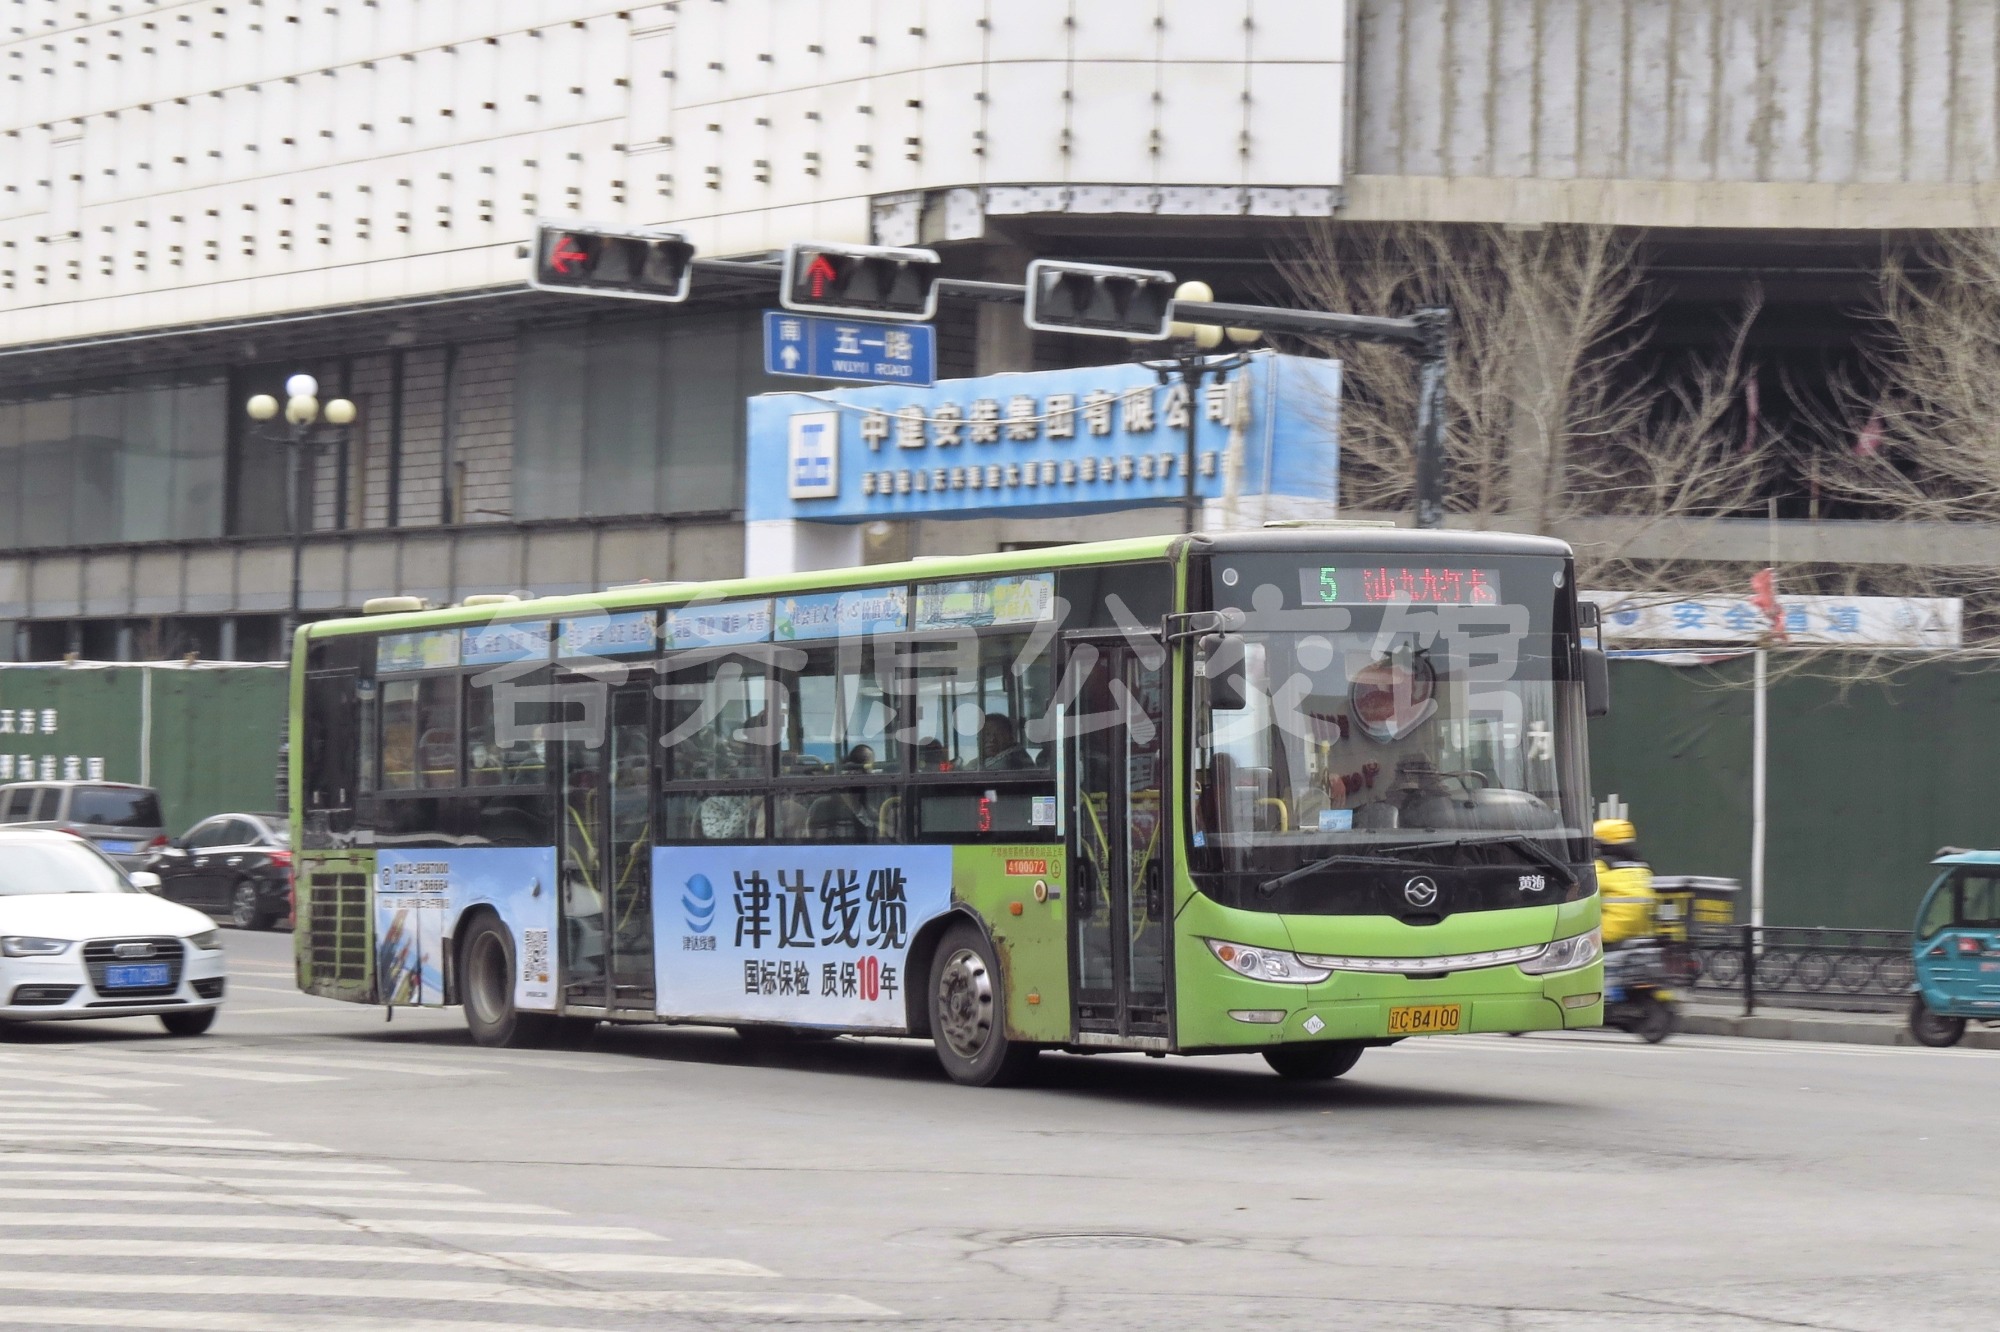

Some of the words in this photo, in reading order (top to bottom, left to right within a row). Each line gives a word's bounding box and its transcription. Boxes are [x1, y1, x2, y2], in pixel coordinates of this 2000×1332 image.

[833, 326, 913, 361] 五一路
[873, 363, 913, 377] ROAD
[859, 380, 1234, 451] 中建安装集团有限公司
[1319, 566, 1337, 602] 5
[978, 796, 992, 832] 5
[1008, 860, 1046, 873] 4100072
[1518, 874, 1546, 891] 黄海
[733, 867, 908, 950] 津达线缆
[682, 935, 717, 951] 津达线缆
[744, 959, 810, 996] 国标保检
[821, 955, 899, 1001] 质保10年
[1306, 1020, 1322, 1030] LNG
